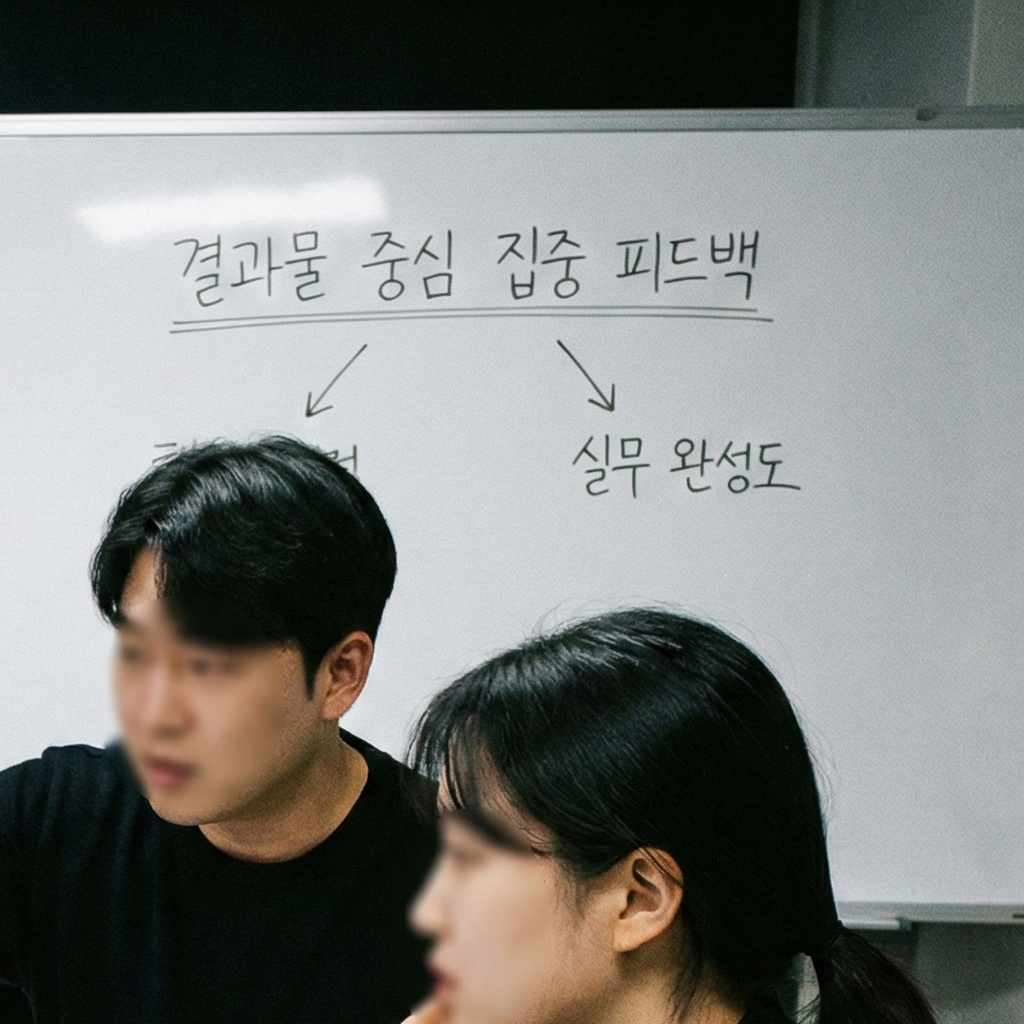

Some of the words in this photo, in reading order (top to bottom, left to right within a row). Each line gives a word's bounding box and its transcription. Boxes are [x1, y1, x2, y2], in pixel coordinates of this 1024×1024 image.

[173, 230, 328, 308] 결과물
[361, 229, 453, 301] 중심
[497, 225, 586, 301] 집중
[615, 230, 760, 301] 피드백
[572, 434, 651, 498] 실무
[669, 437, 802, 495] 완성도
